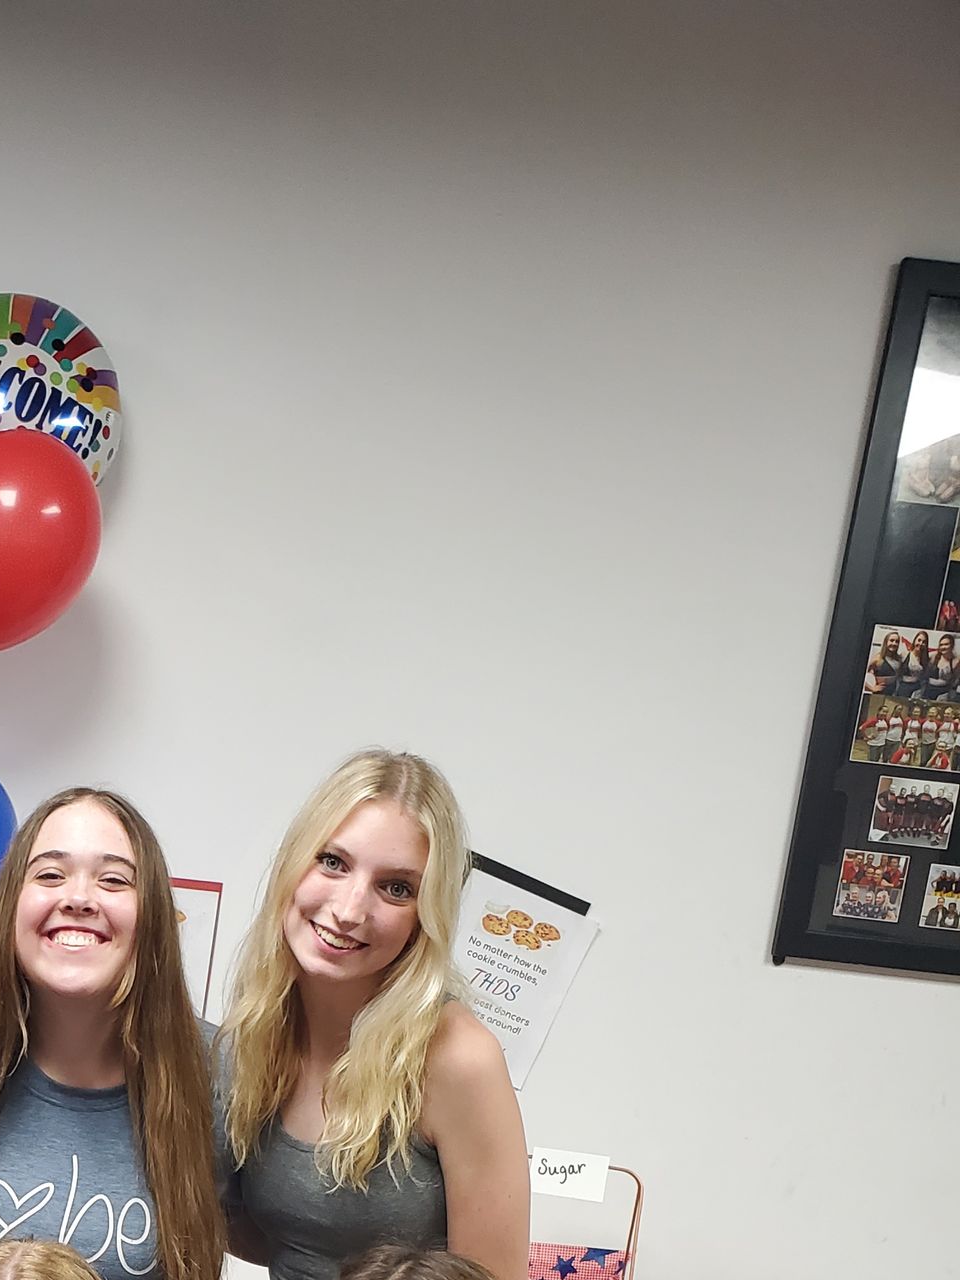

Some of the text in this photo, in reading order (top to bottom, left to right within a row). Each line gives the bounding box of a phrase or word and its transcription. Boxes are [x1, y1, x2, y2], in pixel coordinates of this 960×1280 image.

[467, 949, 538, 986] cookie crumbles,
[468, 935, 547, 976] No matter how the
[470, 968, 521, 1001] THDS
[487, 1016, 522, 1035] around!
[494, 1006, 530, 1027] dancers
[538, 1158, 586, 1184] Sugar
